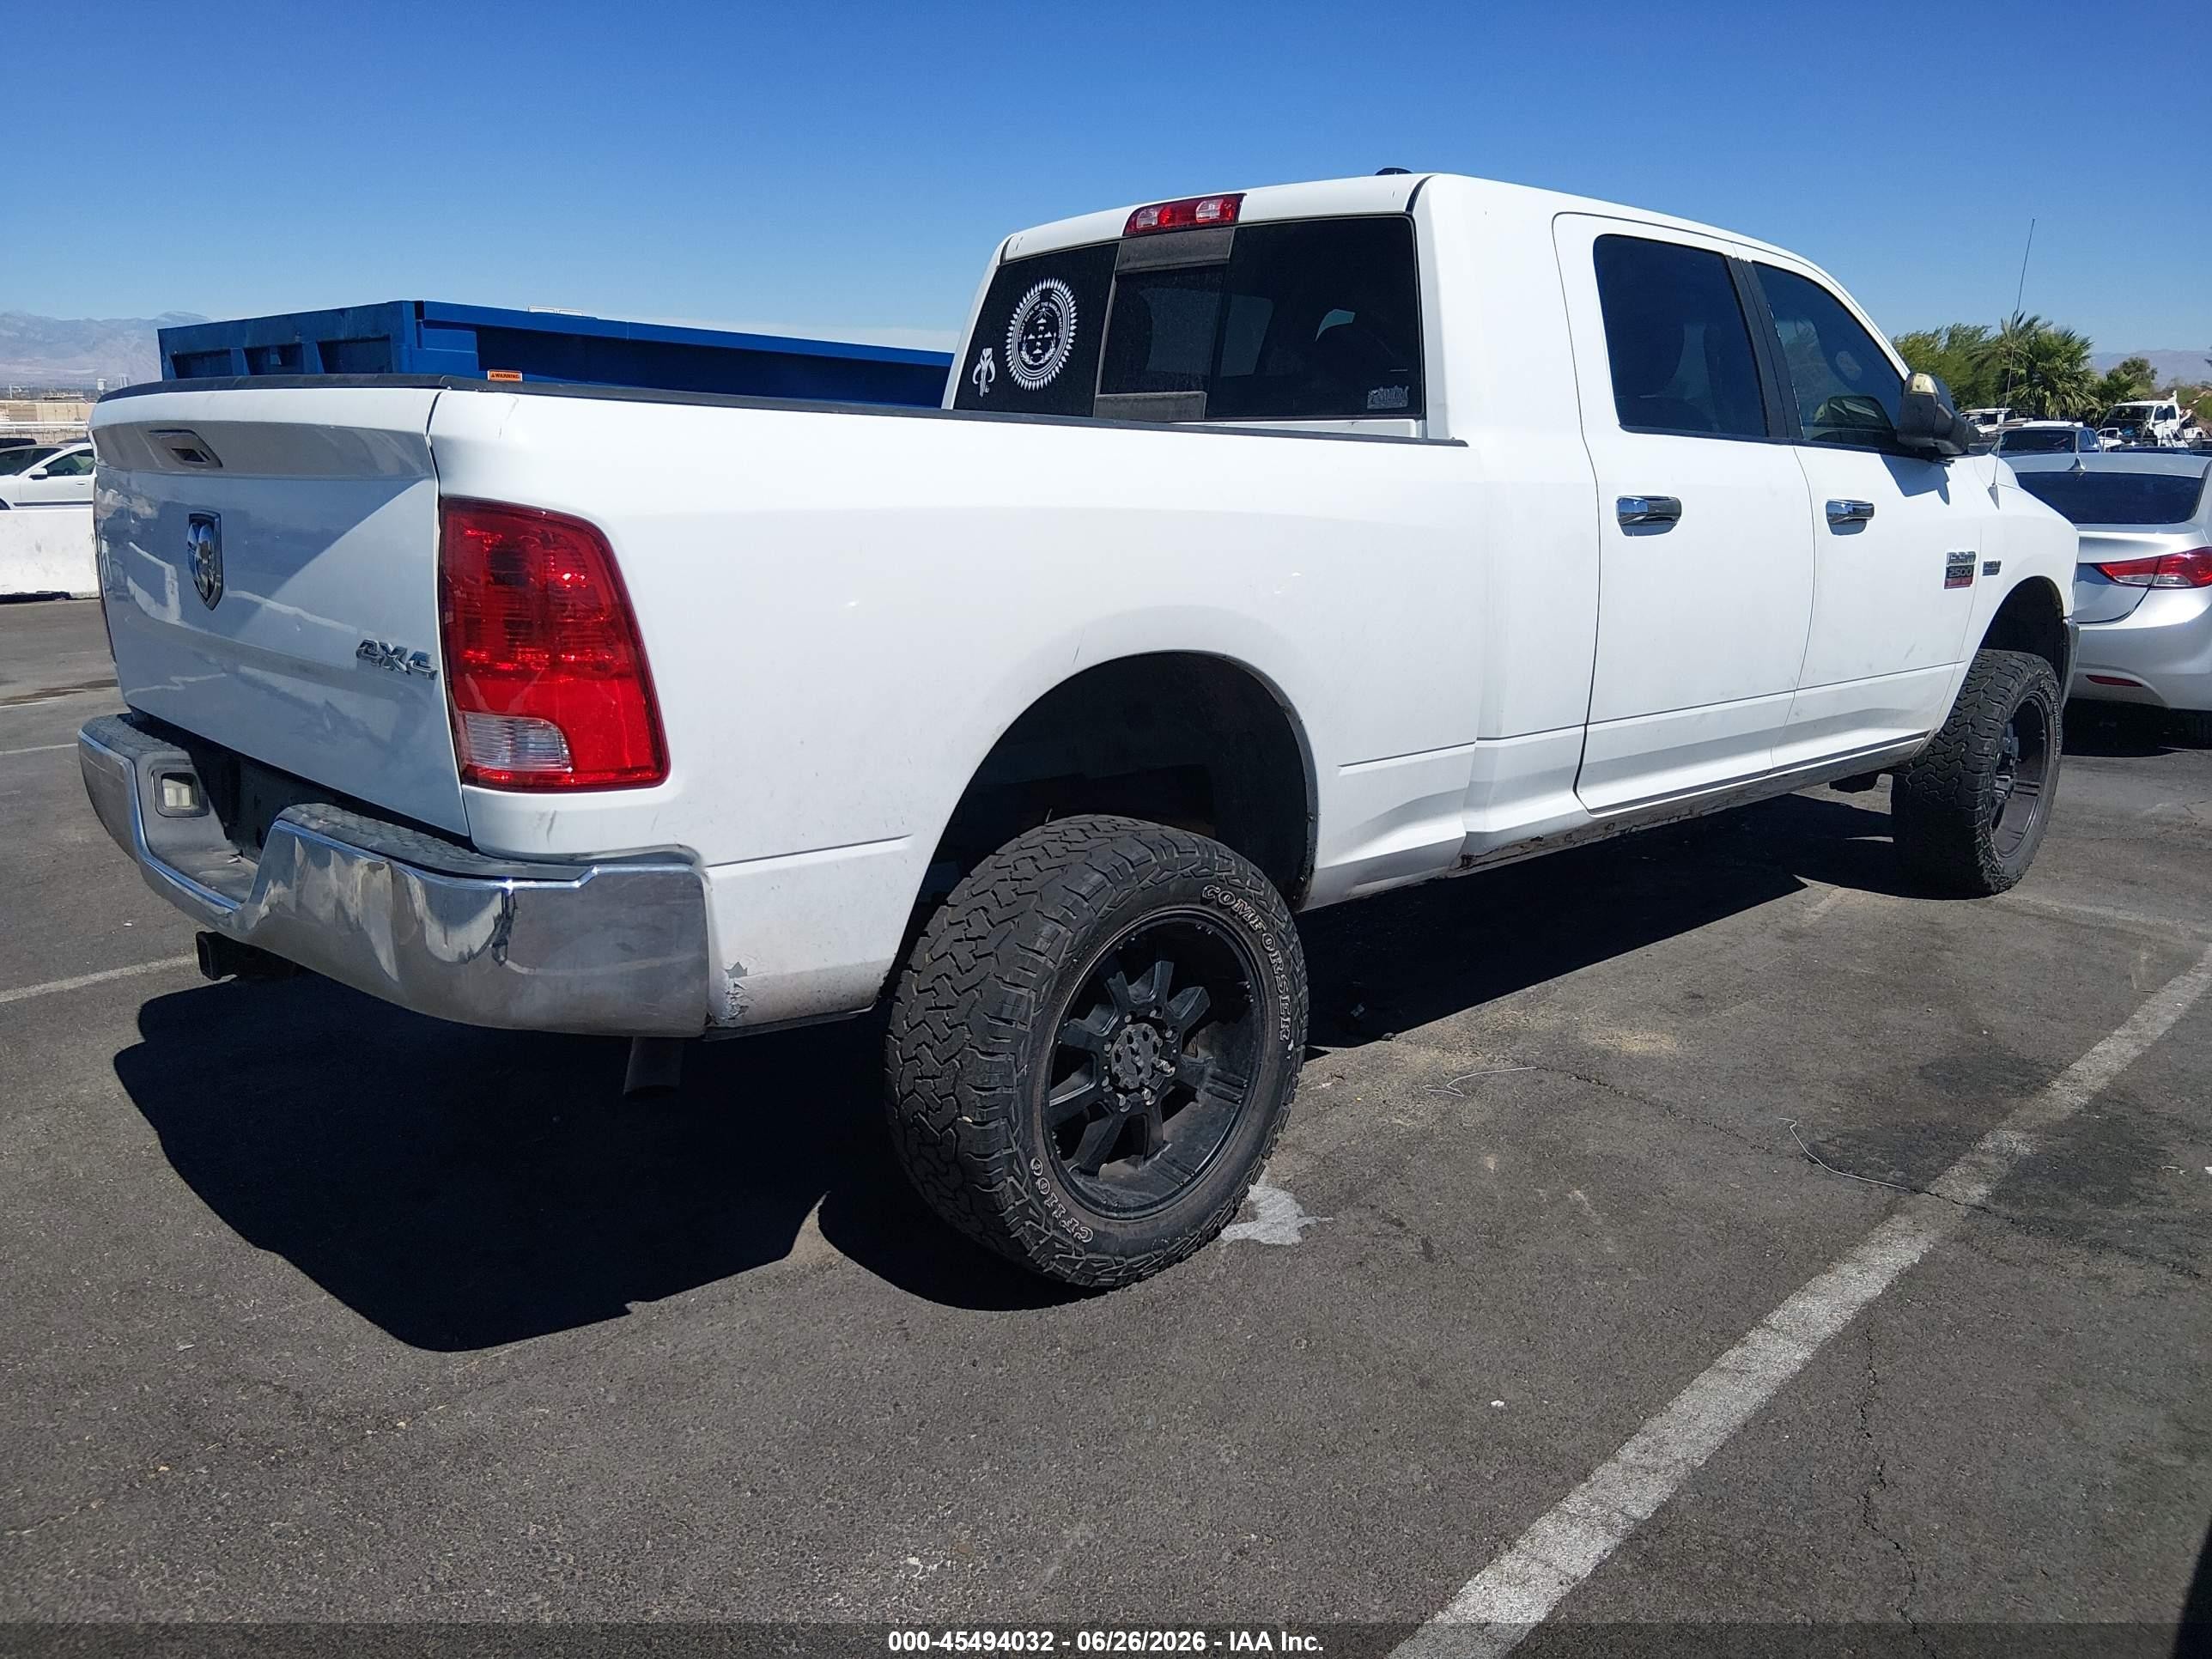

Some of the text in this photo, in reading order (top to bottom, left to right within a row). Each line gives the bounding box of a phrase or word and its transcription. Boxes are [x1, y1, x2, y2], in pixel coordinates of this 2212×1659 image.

[1948, 568, 1972, 578] 2500
[1202, 884, 1291, 1042] COMFORSER
[1030, 1157, 1094, 1243] CF1100
